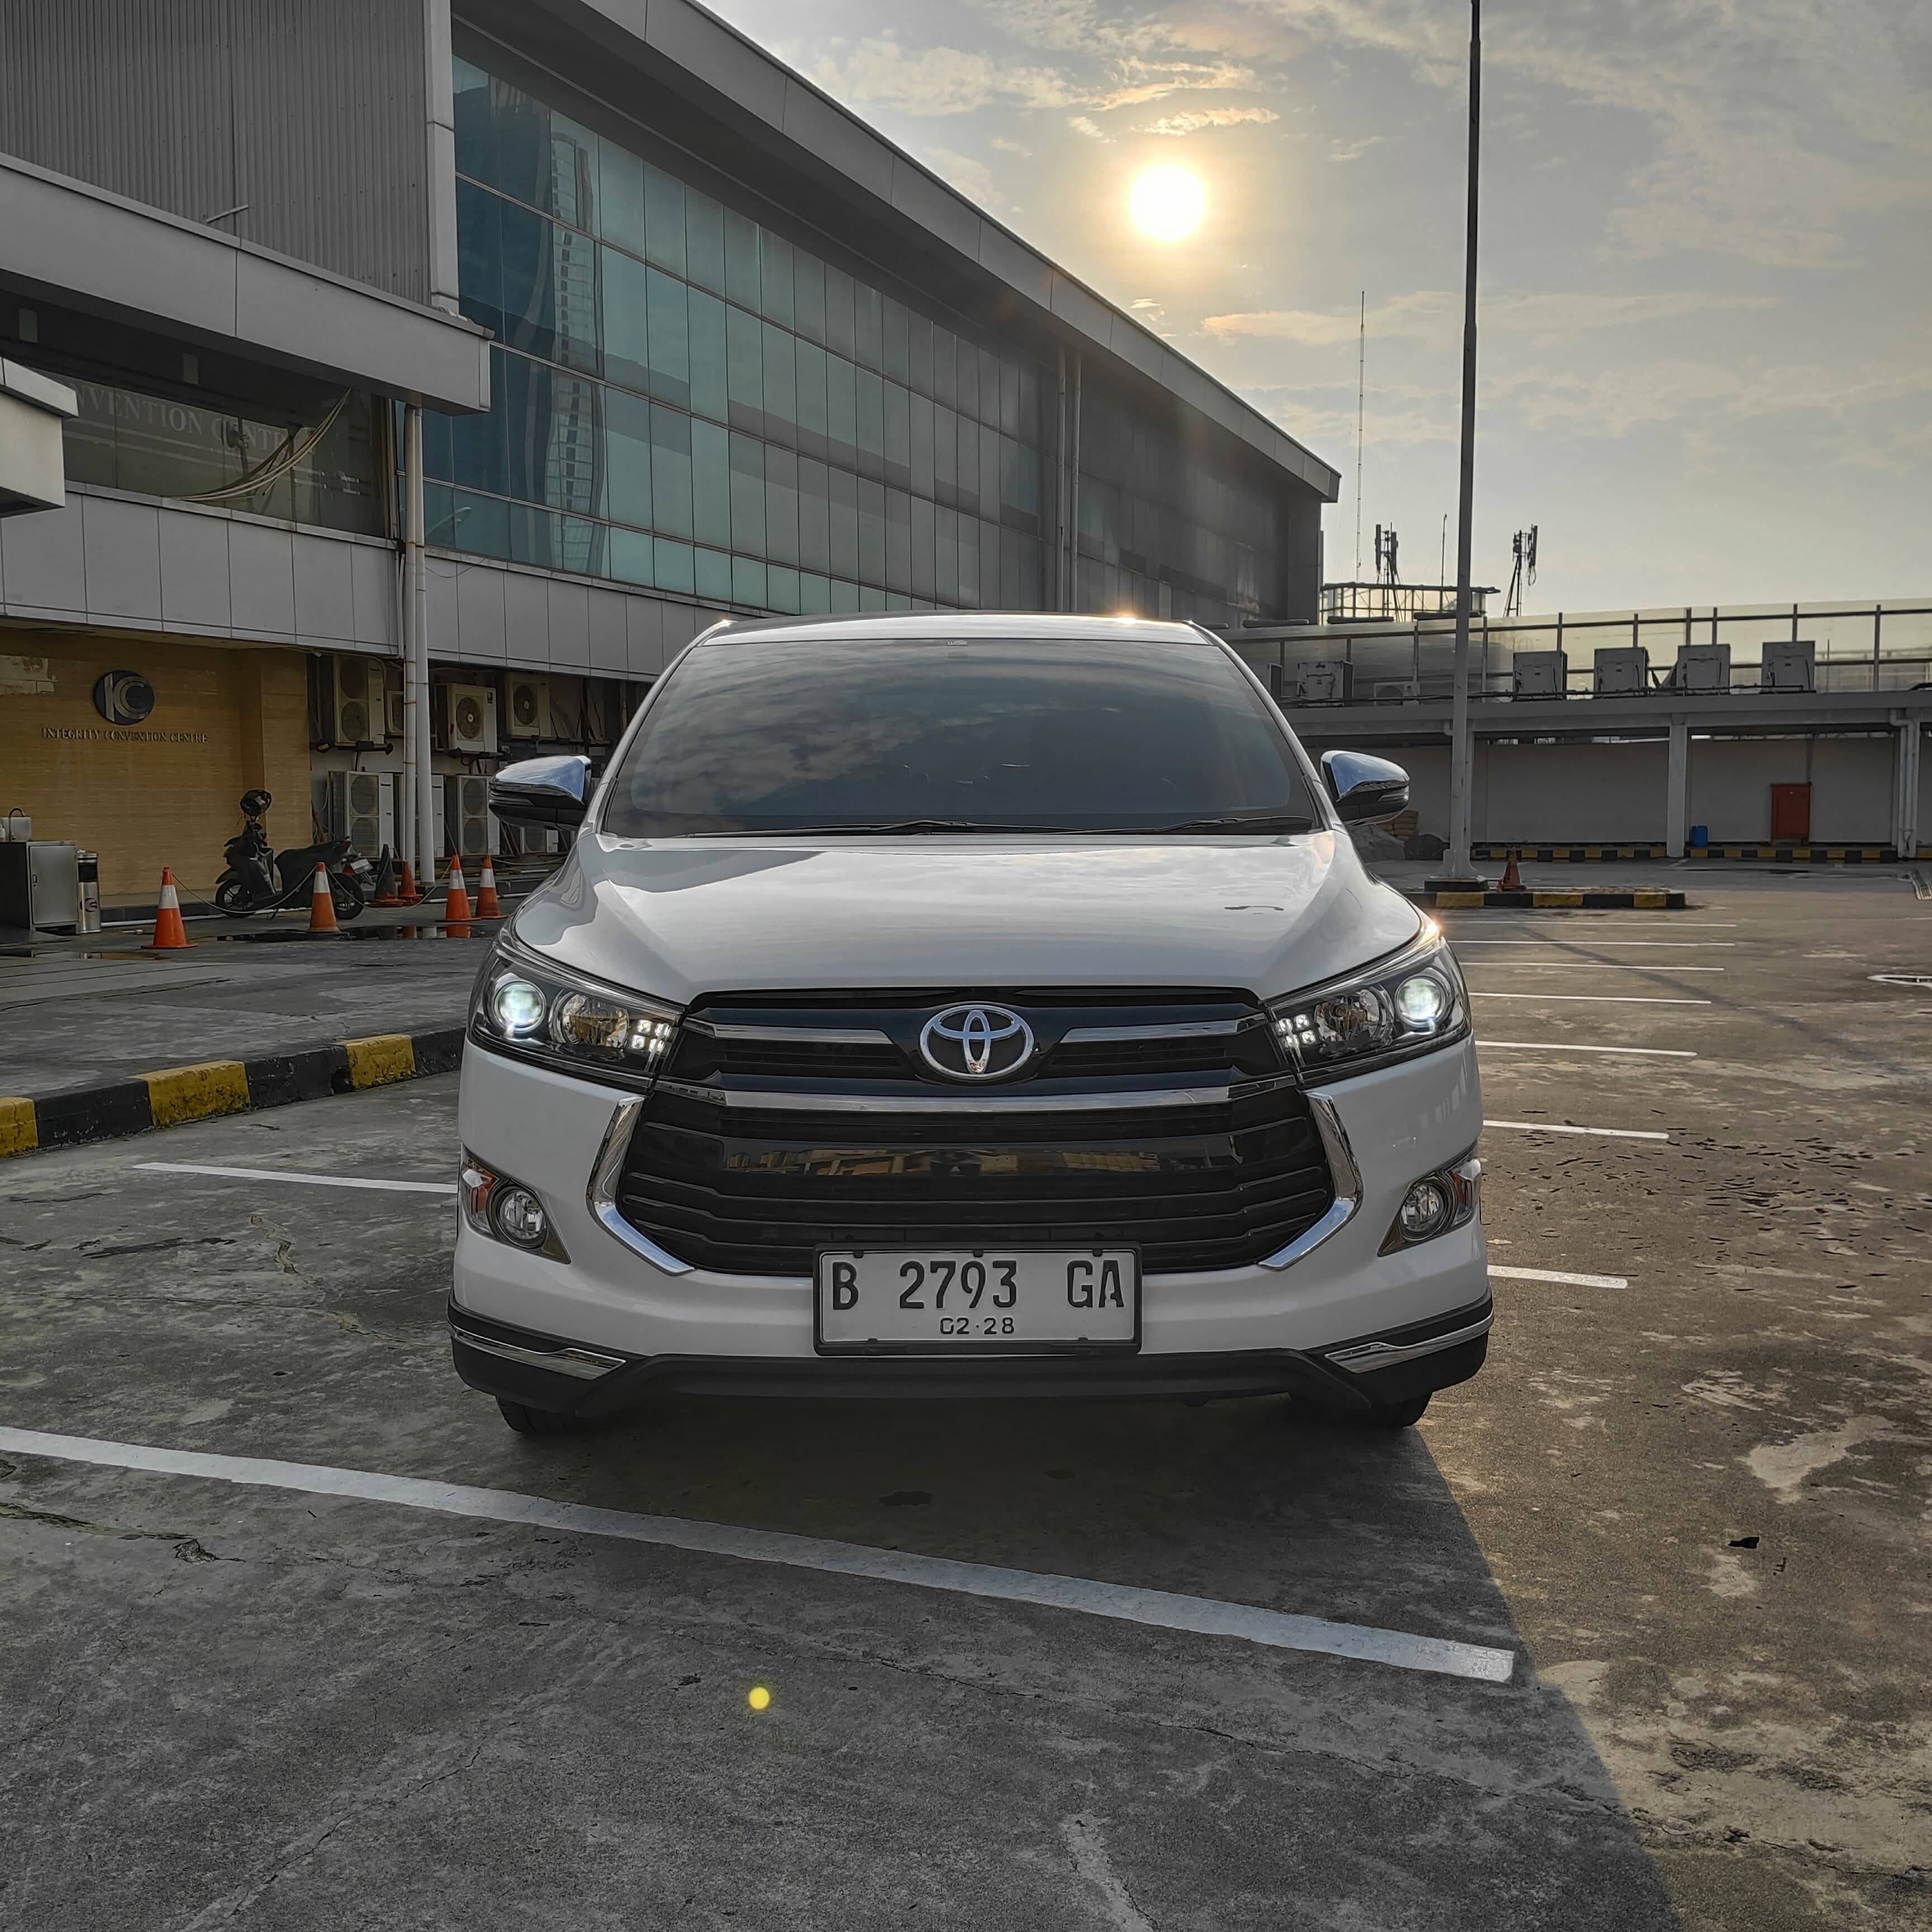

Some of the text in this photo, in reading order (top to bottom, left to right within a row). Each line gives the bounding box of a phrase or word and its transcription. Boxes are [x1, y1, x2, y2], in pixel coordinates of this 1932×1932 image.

[66, 382, 203, 436] NVENTION
[41, 727, 209, 744] INTEGRITY CONVENTION CENTRE
[832, 1259, 1125, 1310] B 2793 GA
